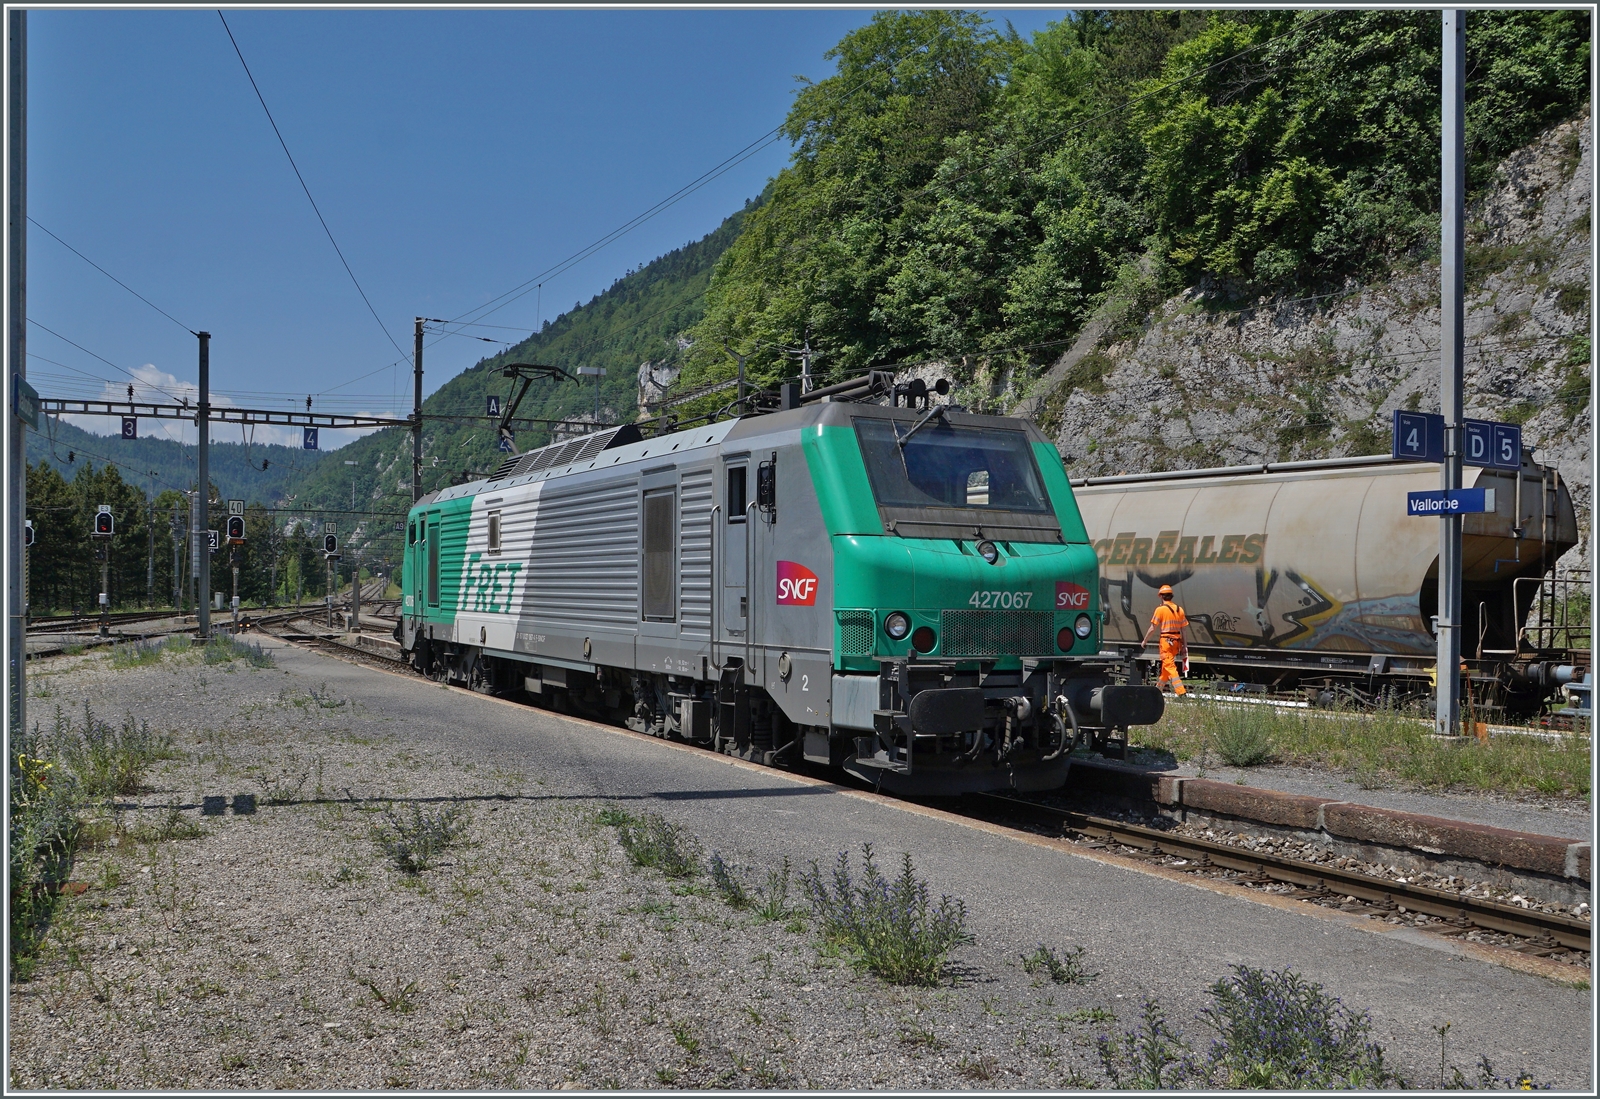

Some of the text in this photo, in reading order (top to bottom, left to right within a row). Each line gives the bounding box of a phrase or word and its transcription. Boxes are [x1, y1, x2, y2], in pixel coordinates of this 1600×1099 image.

[489, 398, 498, 413] A
[124, 421, 134, 436] 3
[306, 431, 315, 447] 4
[1406, 428, 1419, 451] 4
[1471, 435, 1484, 458] D
[1501, 438, 1513, 461] 5
[230, 502, 242, 513] 40
[1410, 497, 1459, 511] Vallorbe
[326, 522, 335, 532] 40
[461, 553, 523, 613] FRET
[778, 578, 816, 600] SNCF
[969, 591, 1033, 609] 427067
[1056, 591, 1089, 606] SNCF
[801, 674, 809, 692] 2
